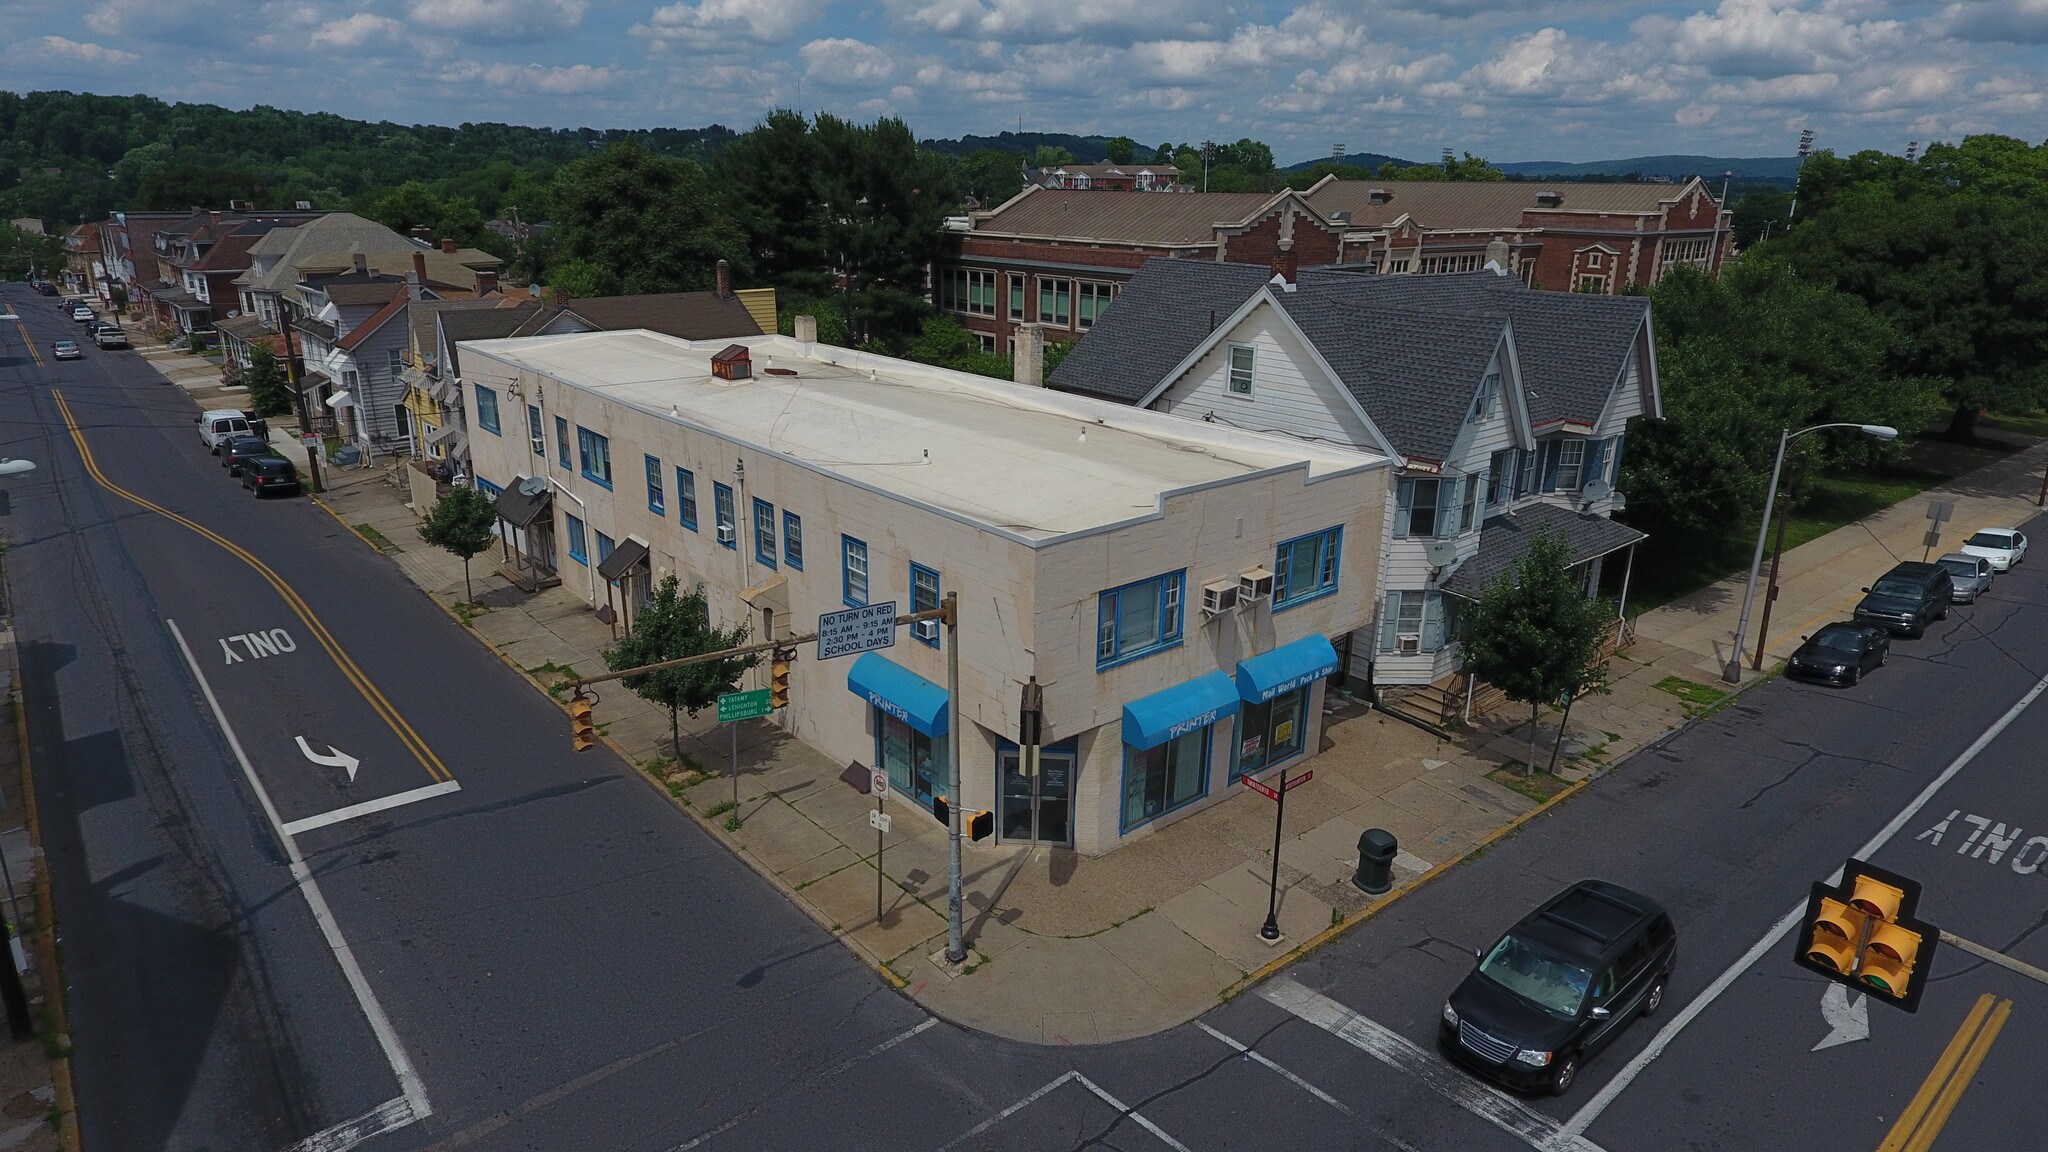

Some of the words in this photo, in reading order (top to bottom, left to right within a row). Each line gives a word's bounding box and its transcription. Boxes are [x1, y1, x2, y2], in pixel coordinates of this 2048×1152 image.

[823, 616, 835, 626] NO
[838, 611, 859, 623] TURN
[862, 608, 873, 618] ON
[876, 605, 892, 615] RED
[822, 629, 838, 638] 8:15
[841, 625, 852, 634] AM
[863, 621, 878, 630] 9:15
[881, 617, 893, 626] AM
[826, 635, 843, 646] 2:30
[846, 632, 858, 641] PM
[868, 629, 873, 637] 4
[877, 627, 888, 636] PM
[218, 628, 296, 665] ONLY
[824, 642, 863, 657] SCHOOL
[866, 636, 889, 647] DAYS
[1278, 679, 1296, 694] World
[1300, 674, 1313, 685] Pack
[1314, 670, 1320, 679] &
[1321, 666, 1333, 676] Ship
[720, 709, 758, 720] PHILLIPSBURG
[728, 701, 758, 711] LEHIGHTON
[1914, 809, 2048, 875] ONLY
